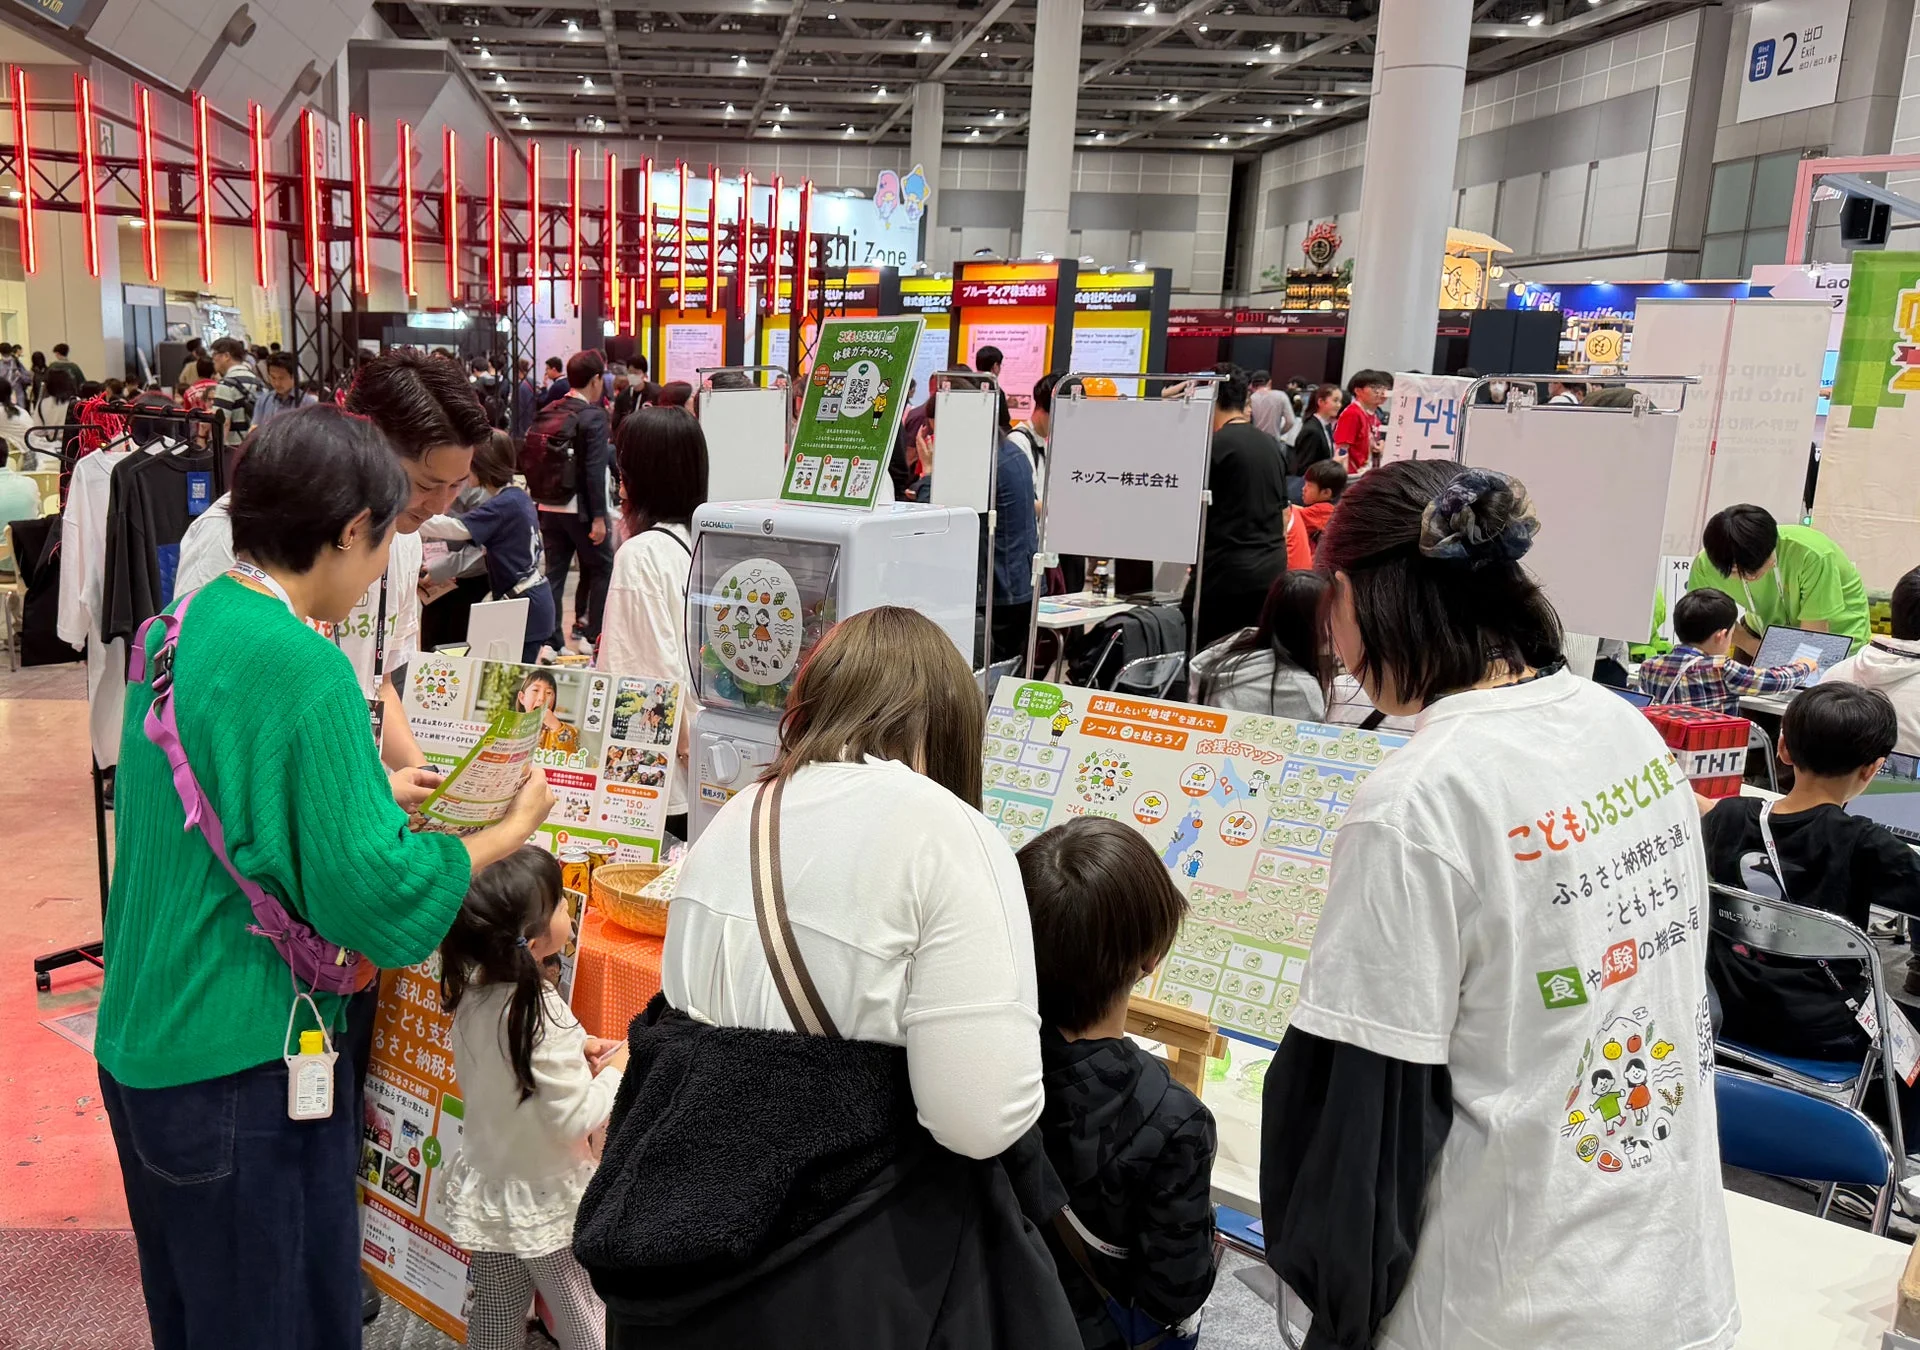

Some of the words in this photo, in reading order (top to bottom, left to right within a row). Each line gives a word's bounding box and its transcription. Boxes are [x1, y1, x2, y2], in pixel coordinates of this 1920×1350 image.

[1803, 25, 1823, 43] 出口
[1777, 32, 1798, 76] 2
[1801, 46, 1815, 59] Exit
[1755, 55, 1768, 78] 西
[865, 241, 907, 266] Zone
[1815, 275, 1850, 290] Lao
[1267, 315, 1286, 324] Findy
[832, 345, 894, 362] 体験ガチャガチャ
[1071, 470, 1179, 488] ネッスー株式会社
[1086, 720, 1117, 736] シール
[533, 750, 566, 767] さと便
[1196, 739, 1284, 765] 応援品マップ
[1694, 751, 1741, 775] TNT
[1507, 757, 1675, 862] こどもふるさと便
